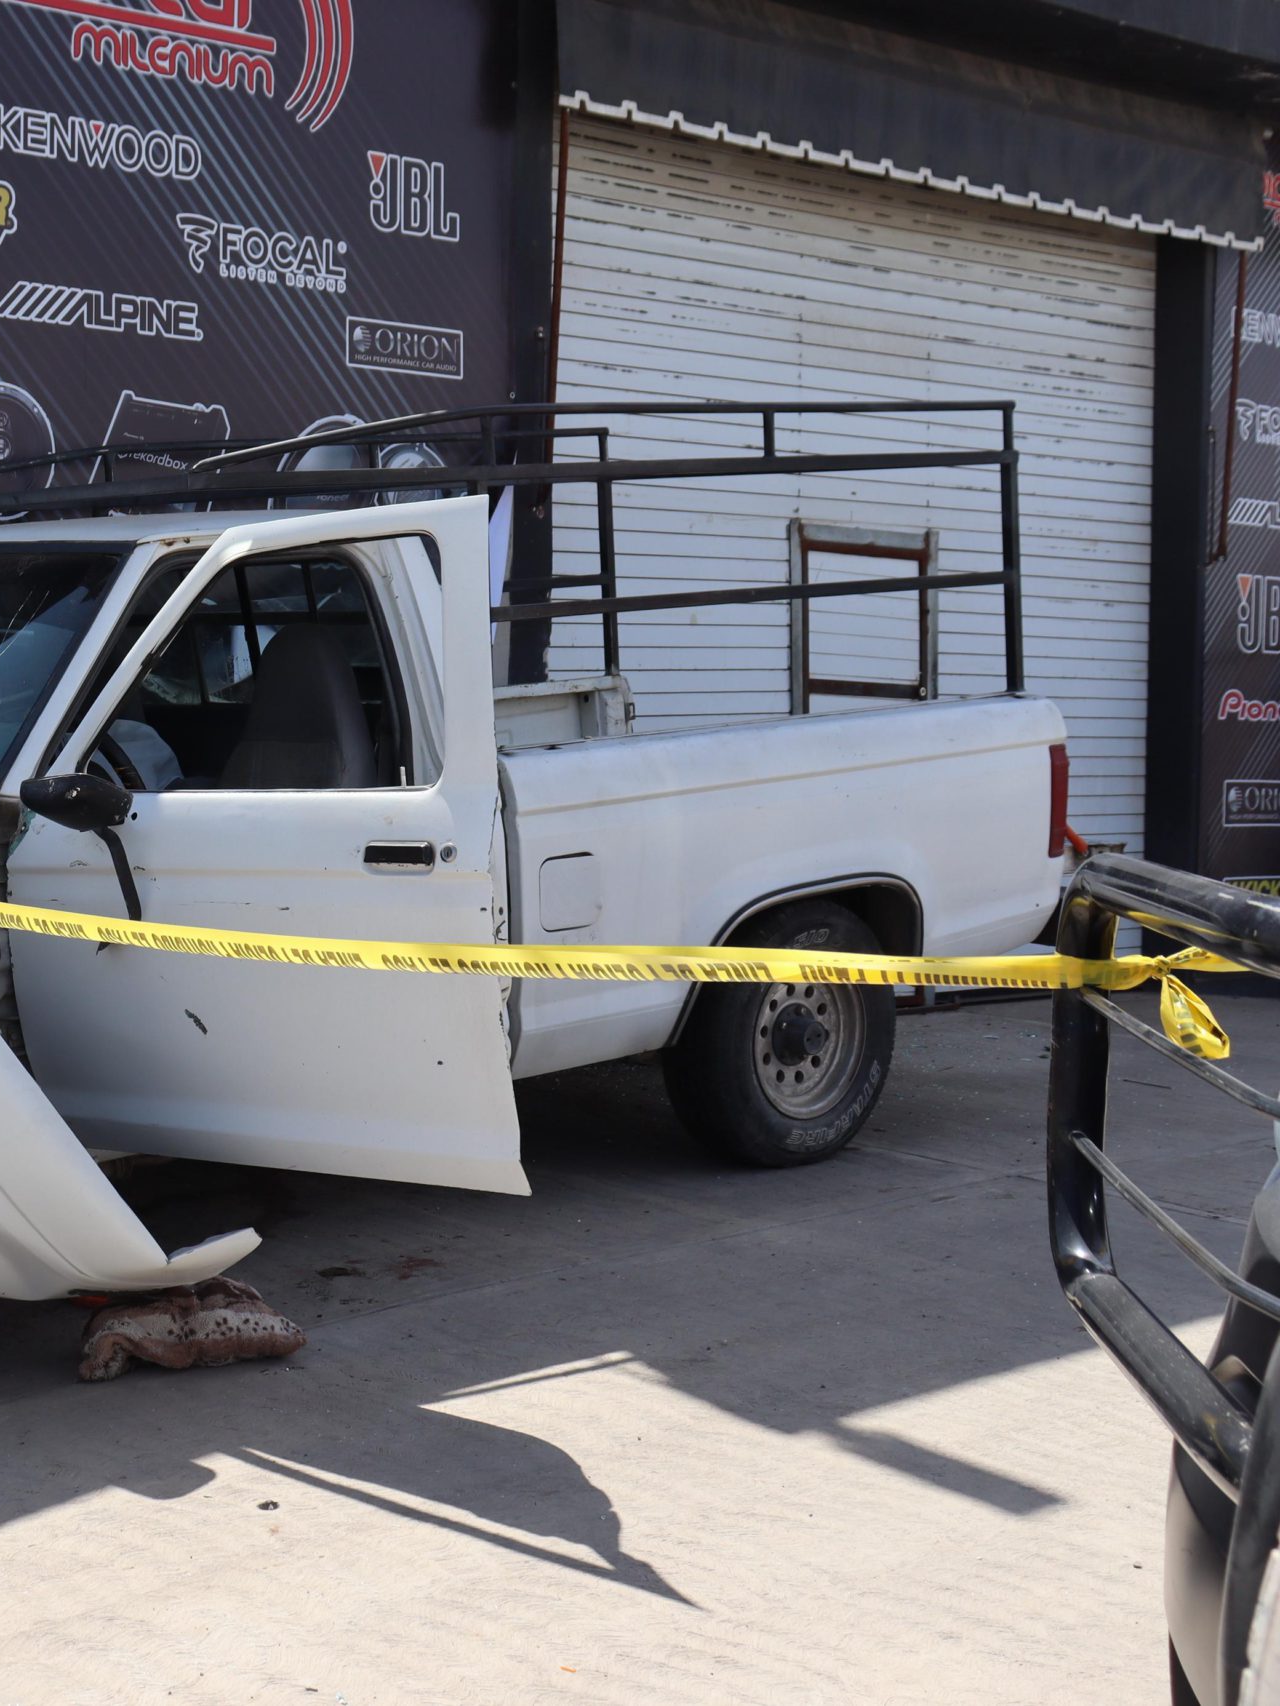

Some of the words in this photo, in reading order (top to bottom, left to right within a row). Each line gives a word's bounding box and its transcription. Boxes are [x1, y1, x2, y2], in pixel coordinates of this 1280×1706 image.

[72, 21, 275, 98] MILENIUM
[368, 152, 460, 242] JBL
[219, 222, 347, 280] FOCAL
[219, 263, 278, 284] LISTEN
[285, 272, 347, 293] BEYOND
[57, 288, 200, 341] ALPINE
[354, 352, 370, 361] HIGH
[372, 355, 421, 369] PERFORMANCE
[421, 360, 435, 370] CAR
[435, 361, 458, 372] AUDIO
[374, 327, 459, 363] ORION
